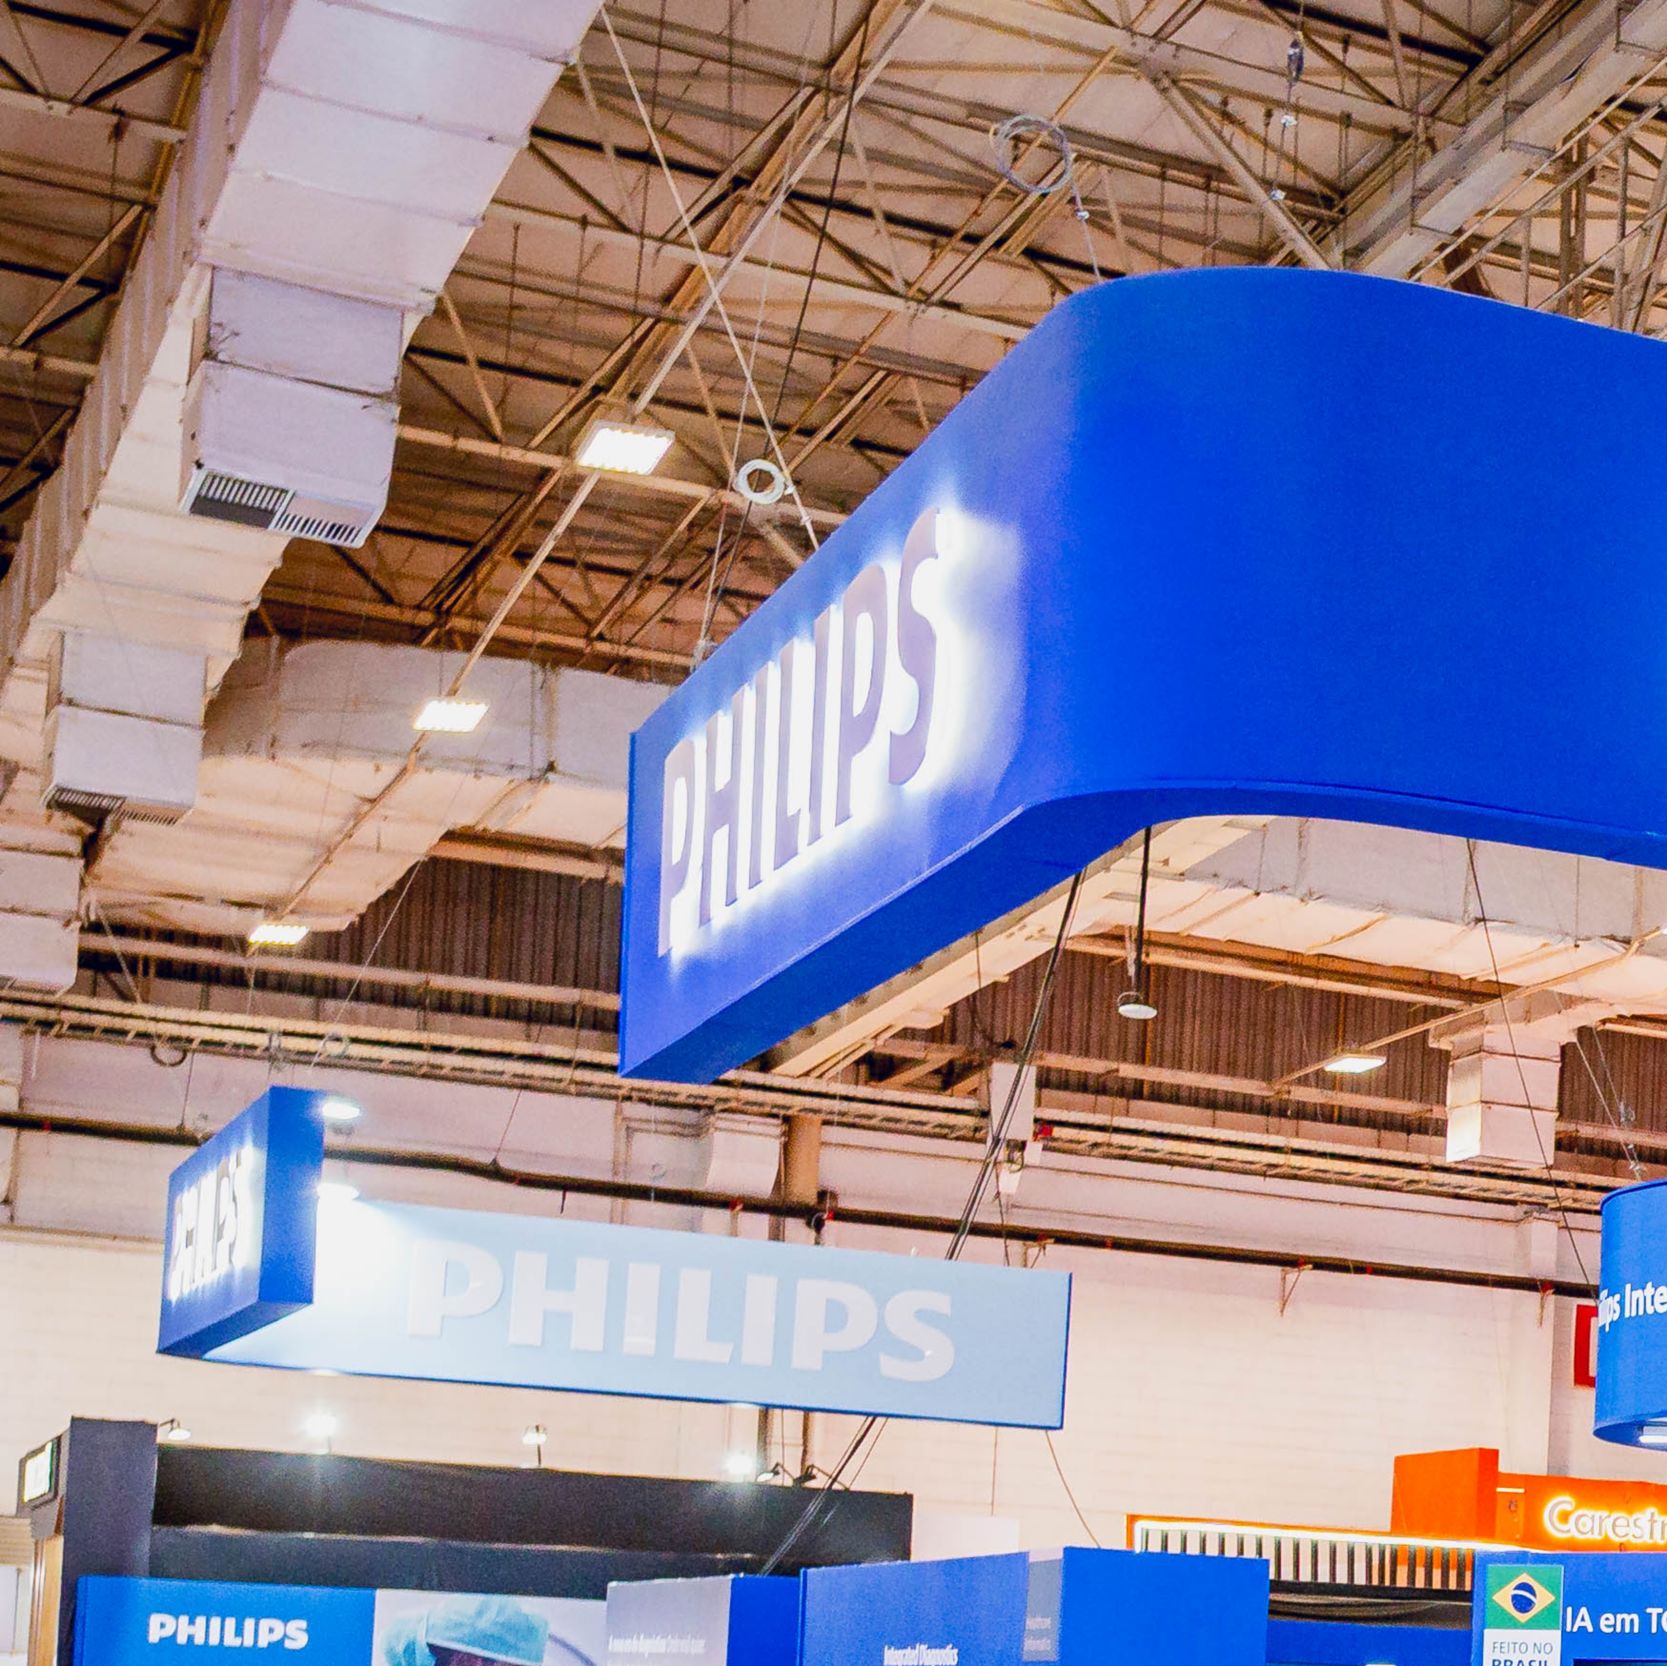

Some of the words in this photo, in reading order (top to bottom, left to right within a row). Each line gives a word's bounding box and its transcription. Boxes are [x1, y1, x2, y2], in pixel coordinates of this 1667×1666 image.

[658, 508, 942, 957] PHILIPS
[407, 1239, 958, 1382] PHILIPS
[148, 1613, 308, 1649] PHILIPS
[1566, 1608, 1593, 1634] IA
[1601, 1616, 1640, 1634] em
[1492, 1641, 1530, 1656] FEITO
[1534, 1641, 1553, 1656] NO
